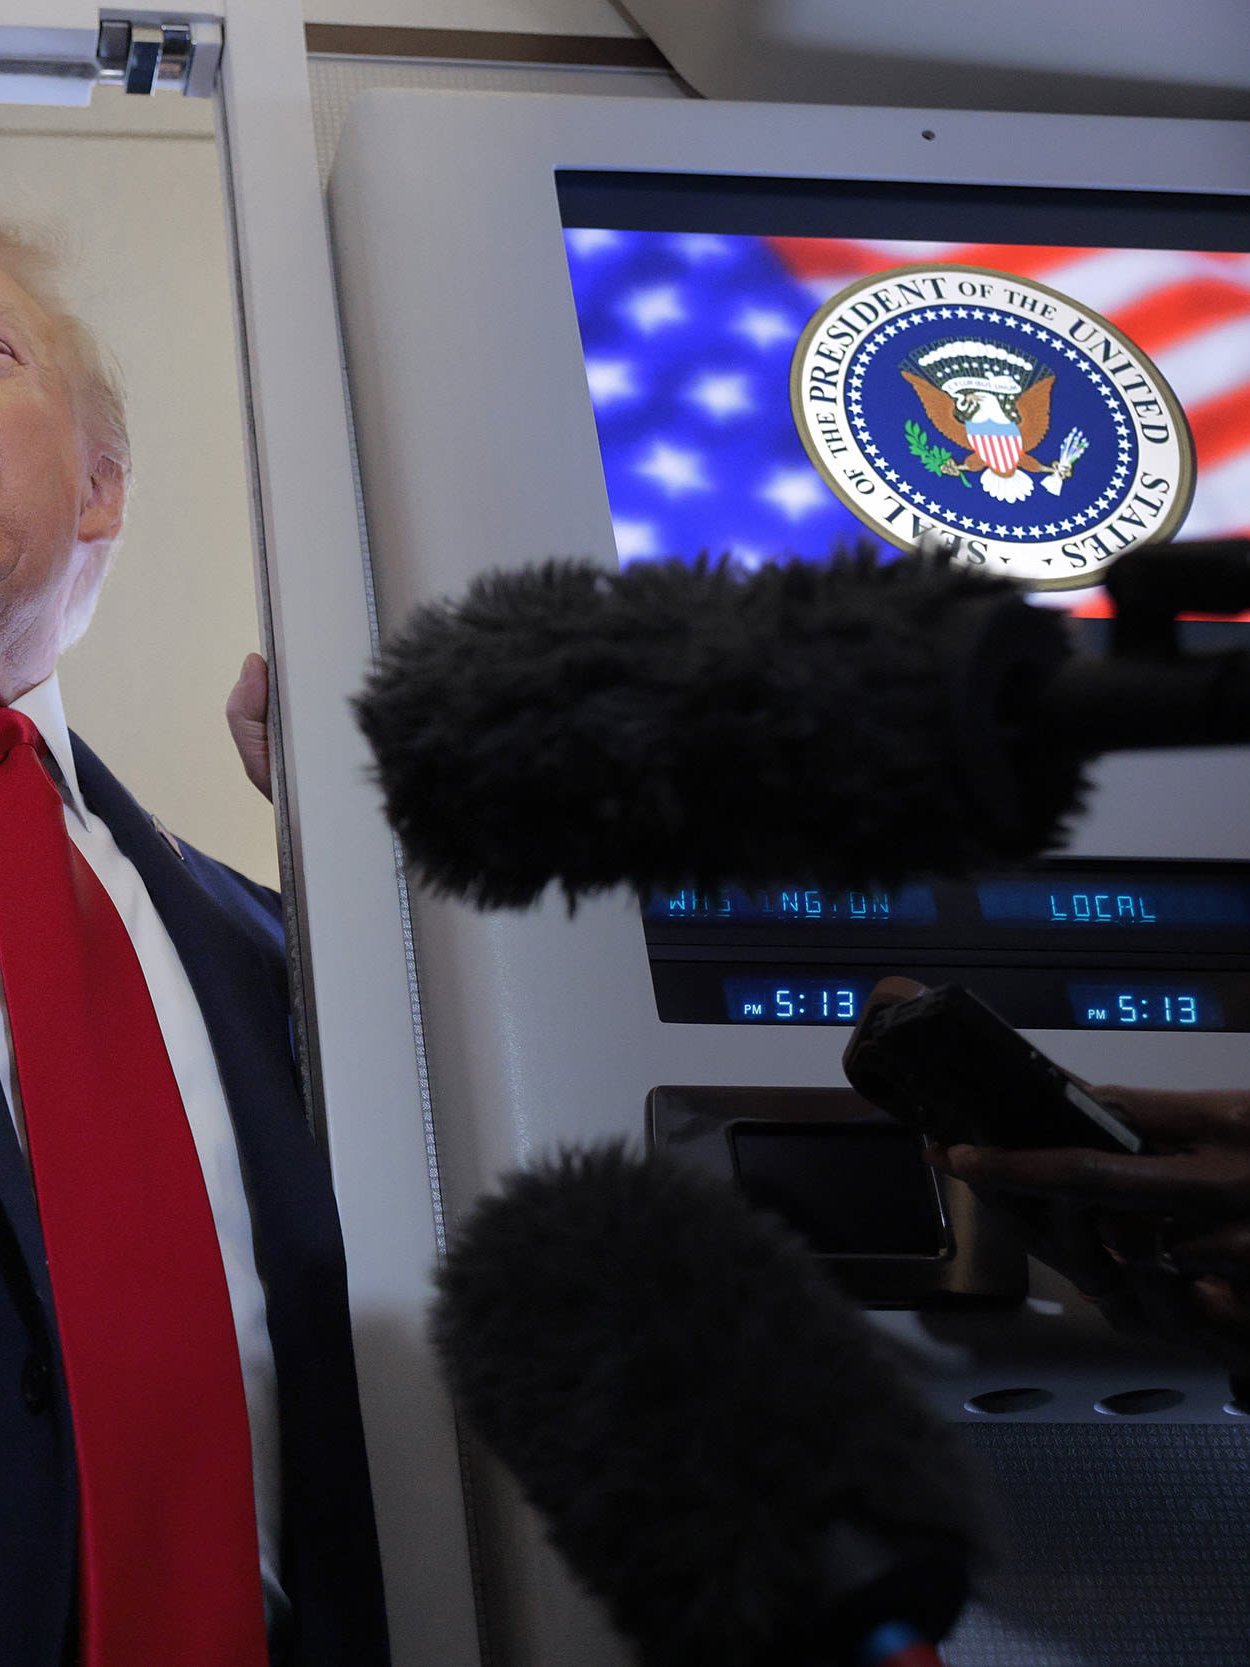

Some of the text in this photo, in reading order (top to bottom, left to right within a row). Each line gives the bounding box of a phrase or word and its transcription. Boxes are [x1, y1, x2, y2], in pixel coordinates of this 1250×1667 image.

[809, 276, 1171, 568] SEAL OF THE PRESIDENT OF THE UNITED STATES
[1050, 894, 1157, 919] LOCAL
[743, 989, 854, 1018] PM 5:13
[1087, 995, 1197, 1024] PM 5:13
